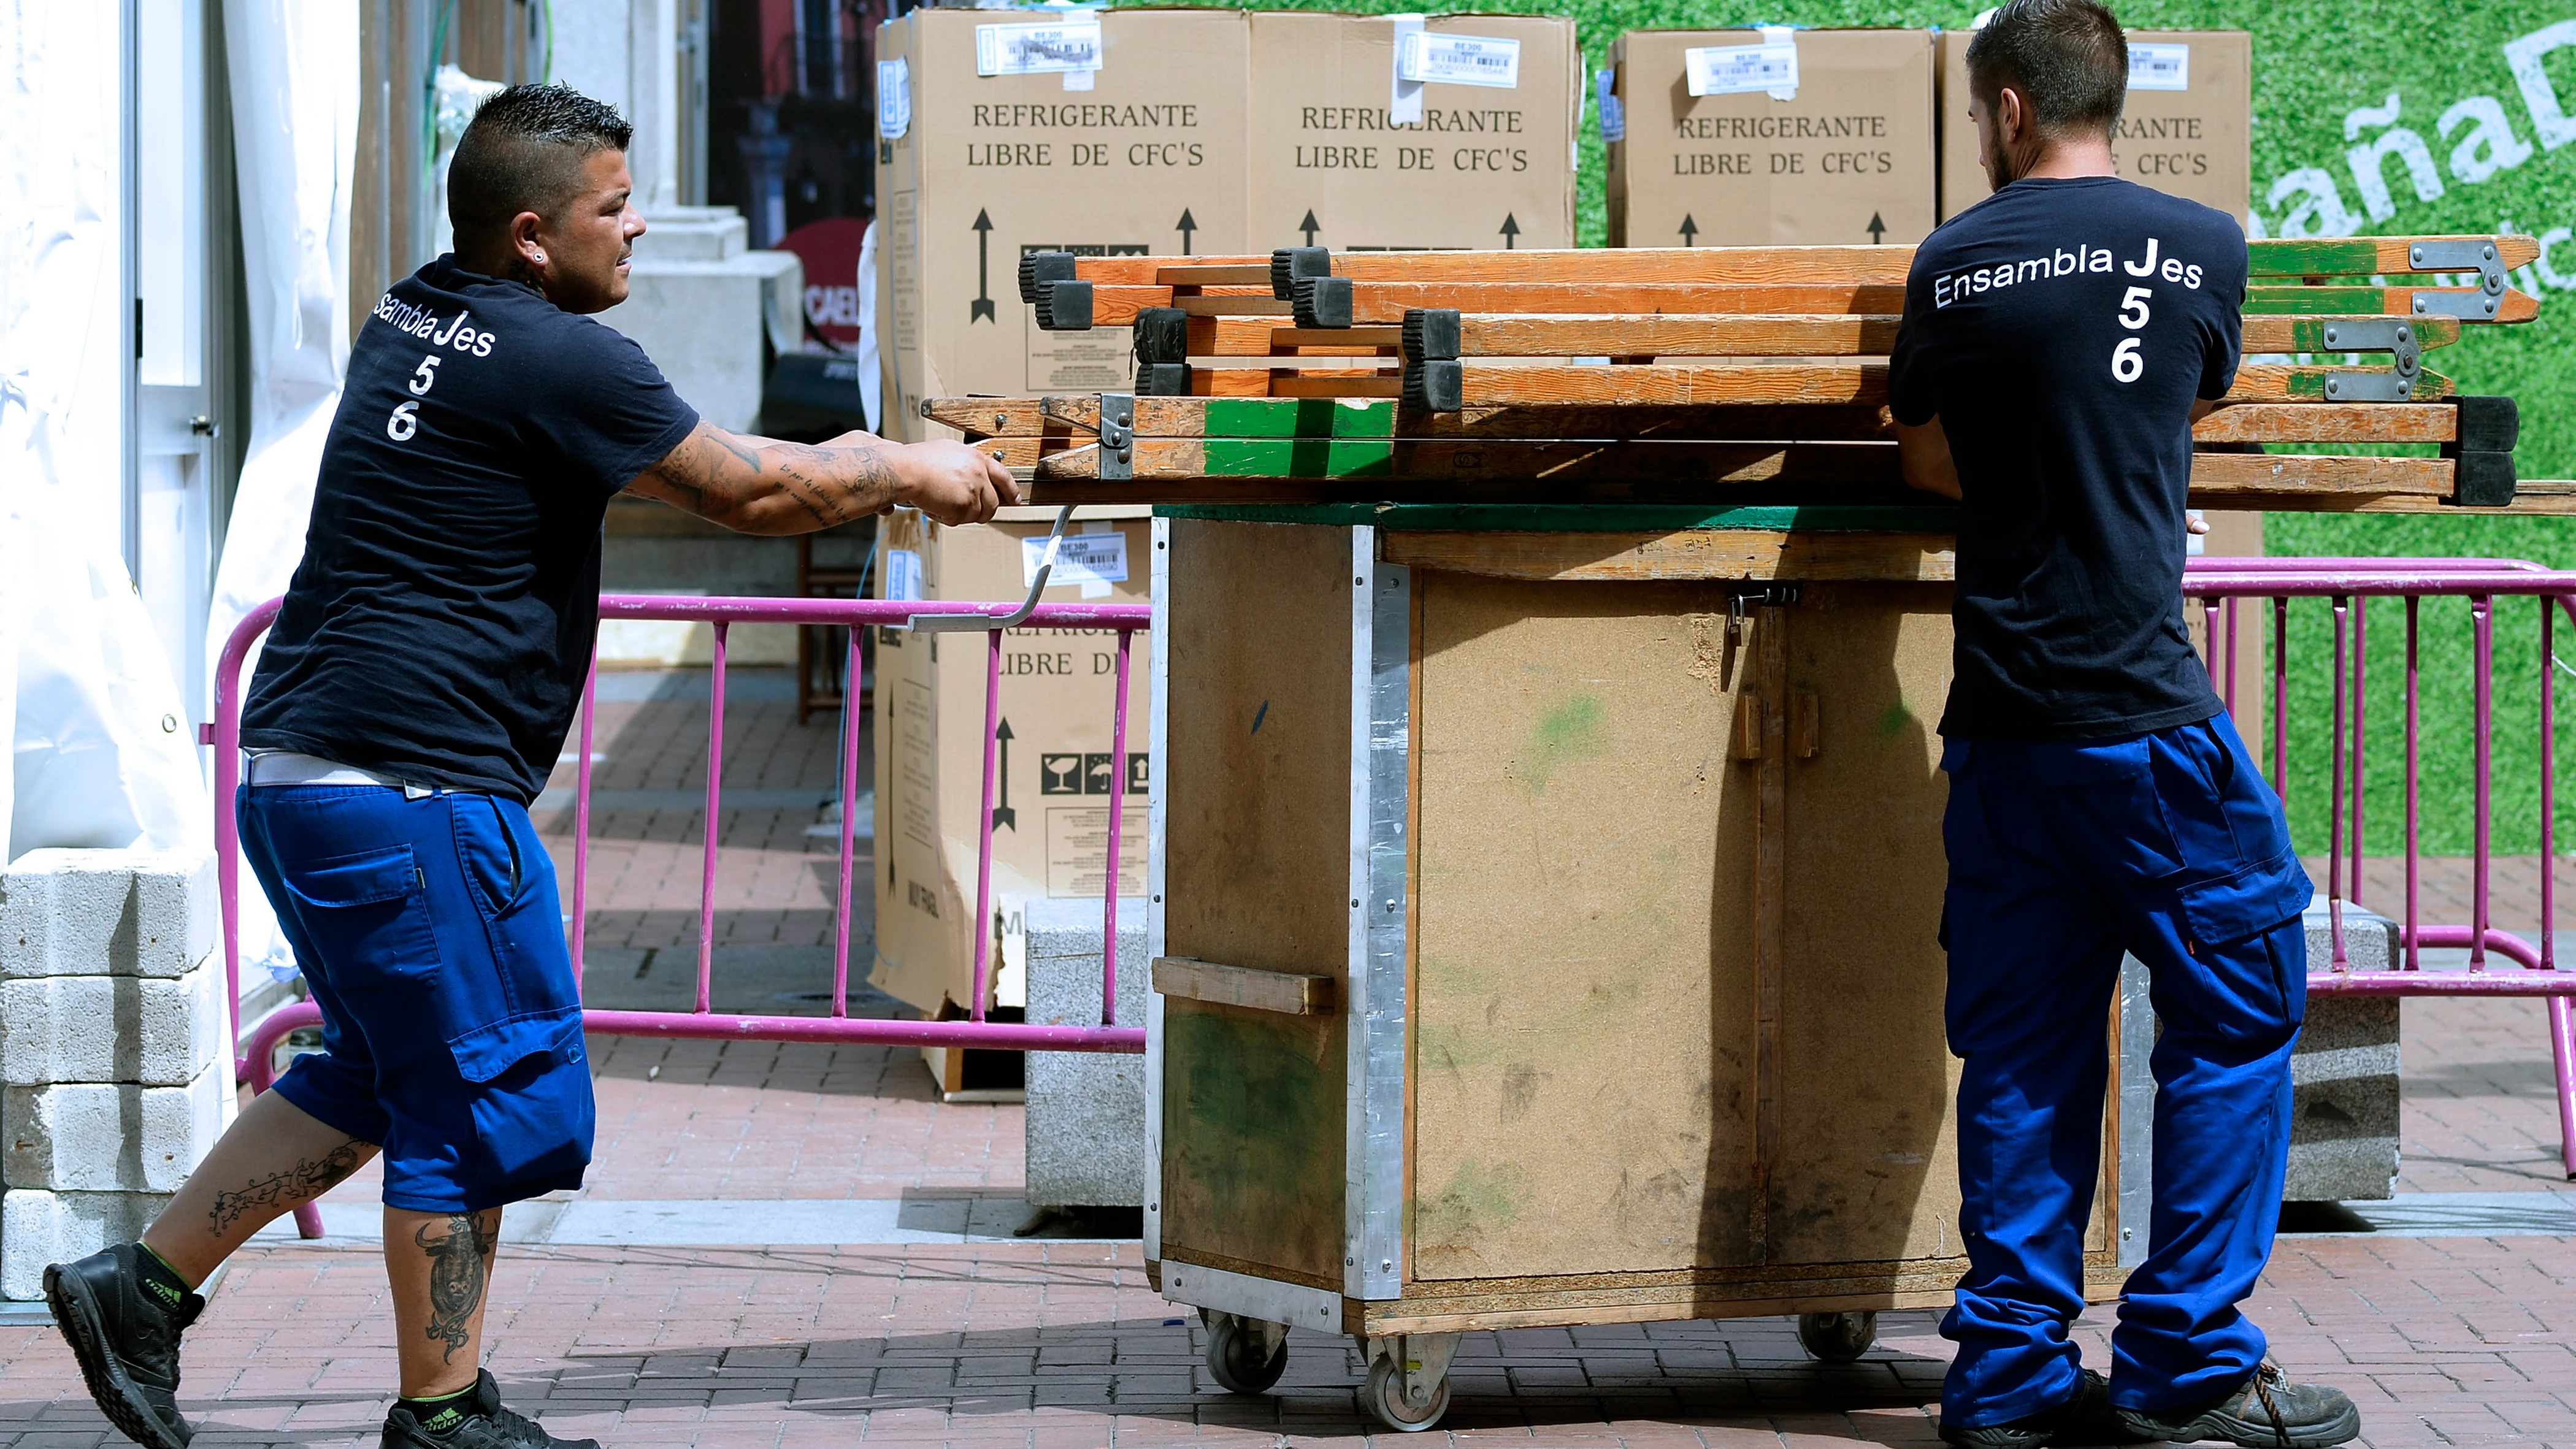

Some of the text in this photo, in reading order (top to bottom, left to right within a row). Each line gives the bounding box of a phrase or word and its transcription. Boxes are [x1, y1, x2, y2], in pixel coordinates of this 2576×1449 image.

[973, 104, 1198, 128] REFRIGERANTE
[1678, 116, 1886, 139] REFRIGERANTE
[2116, 117, 2202, 139] RANTE
[968, 142, 1203, 166] LIBRE DE CFC'S
[1295, 145, 1527, 172] LIBRE DE CFC'S
[1673, 151, 1892, 175] LIBRE DE CFC'S
[2137, 151, 2207, 175] CFC'S
[1934, 243, 2114, 308] Ensambla
[2118, 286, 2152, 329] 5
[2111, 337, 2144, 383] 6
[408, 354, 442, 396] 5
[387, 400, 420, 442] 6
[999, 652, 1119, 675] IBRE D
